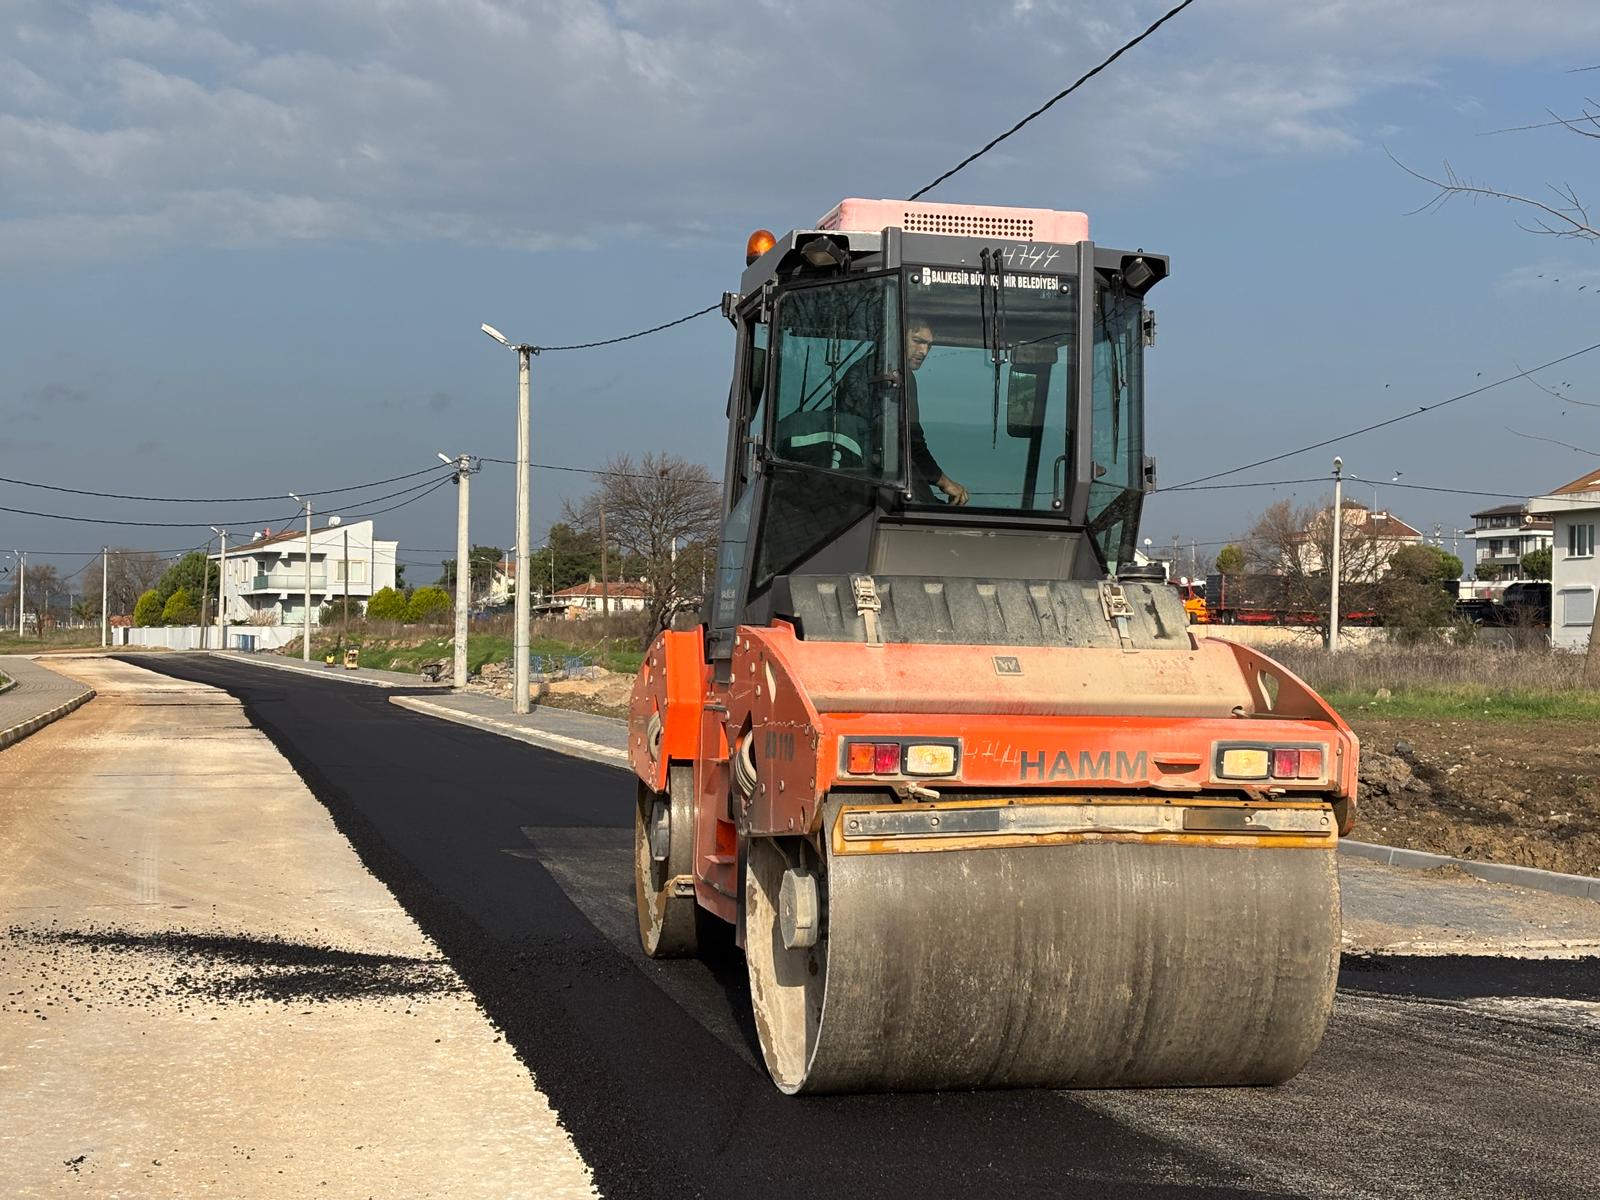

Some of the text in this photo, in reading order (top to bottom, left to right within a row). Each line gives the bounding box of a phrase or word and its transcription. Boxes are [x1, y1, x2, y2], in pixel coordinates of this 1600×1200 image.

[1003, 244, 1060, 269] 4744
[931, 270, 969, 285] BALIKESİR
[970, 271, 1017, 290] BÜYKŞHİR
[1017, 275, 1059, 291] BELEDİYESİ
[1020, 750, 1148, 780] HAMM
